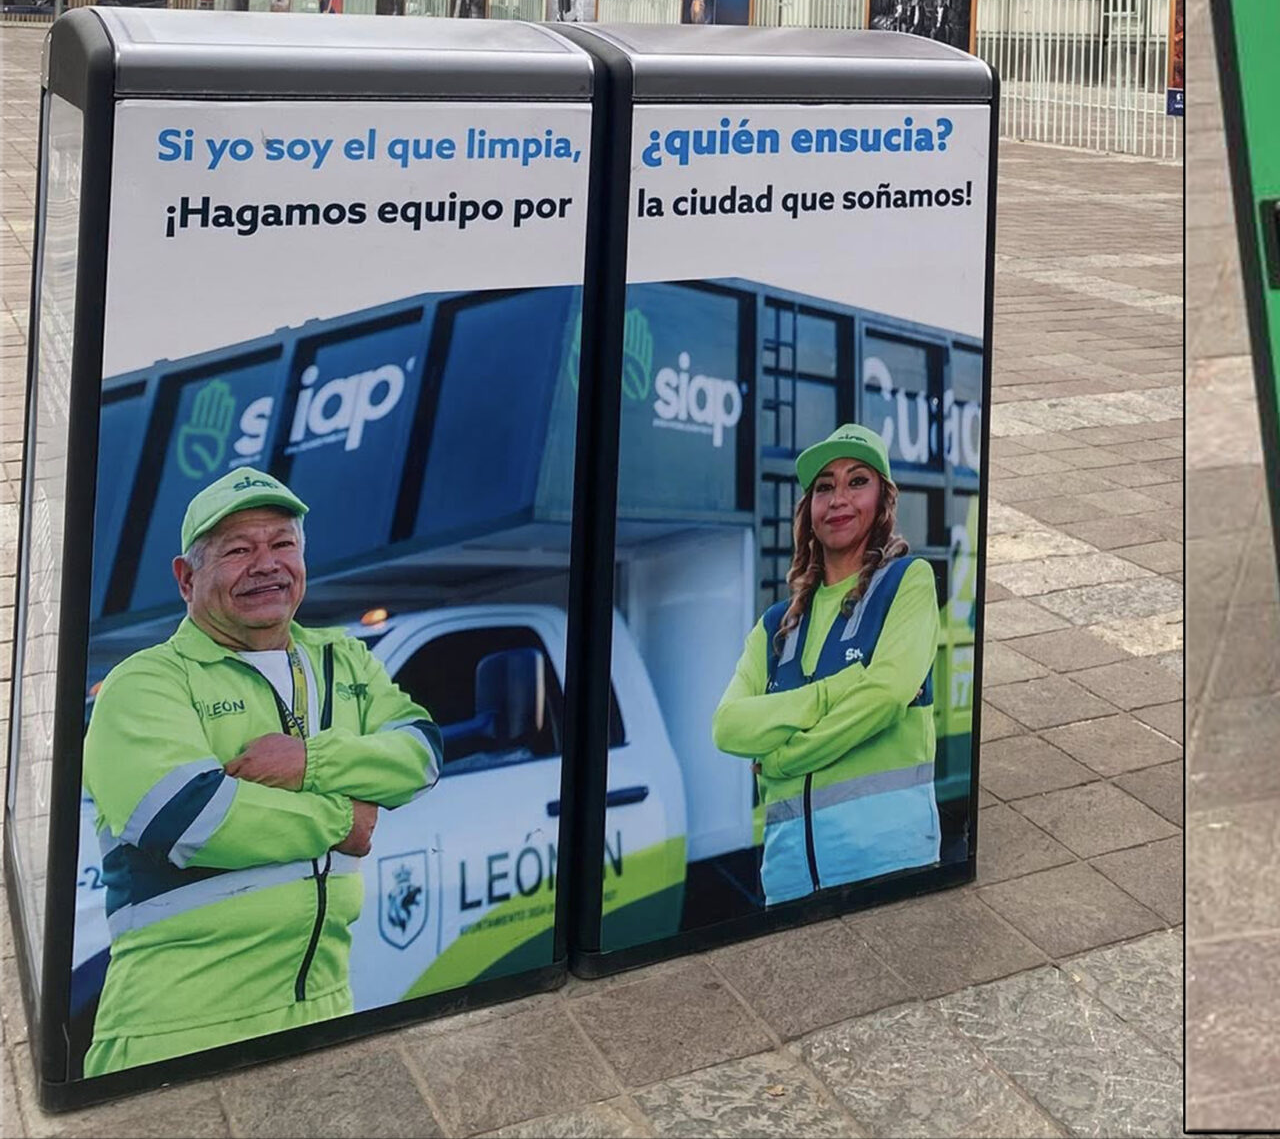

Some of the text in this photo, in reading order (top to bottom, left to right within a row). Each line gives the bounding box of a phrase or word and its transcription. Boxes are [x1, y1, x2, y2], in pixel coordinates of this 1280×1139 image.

[157, 128, 582, 170] Si yo soy el que limpia,
[641, 117, 954, 168] ¿quién ensucia?
[165, 192, 573, 237] ¡Hagamos equipo por
[637, 180, 973, 220] la ciudad que soñamos!
[653, 351, 743, 448] siap
